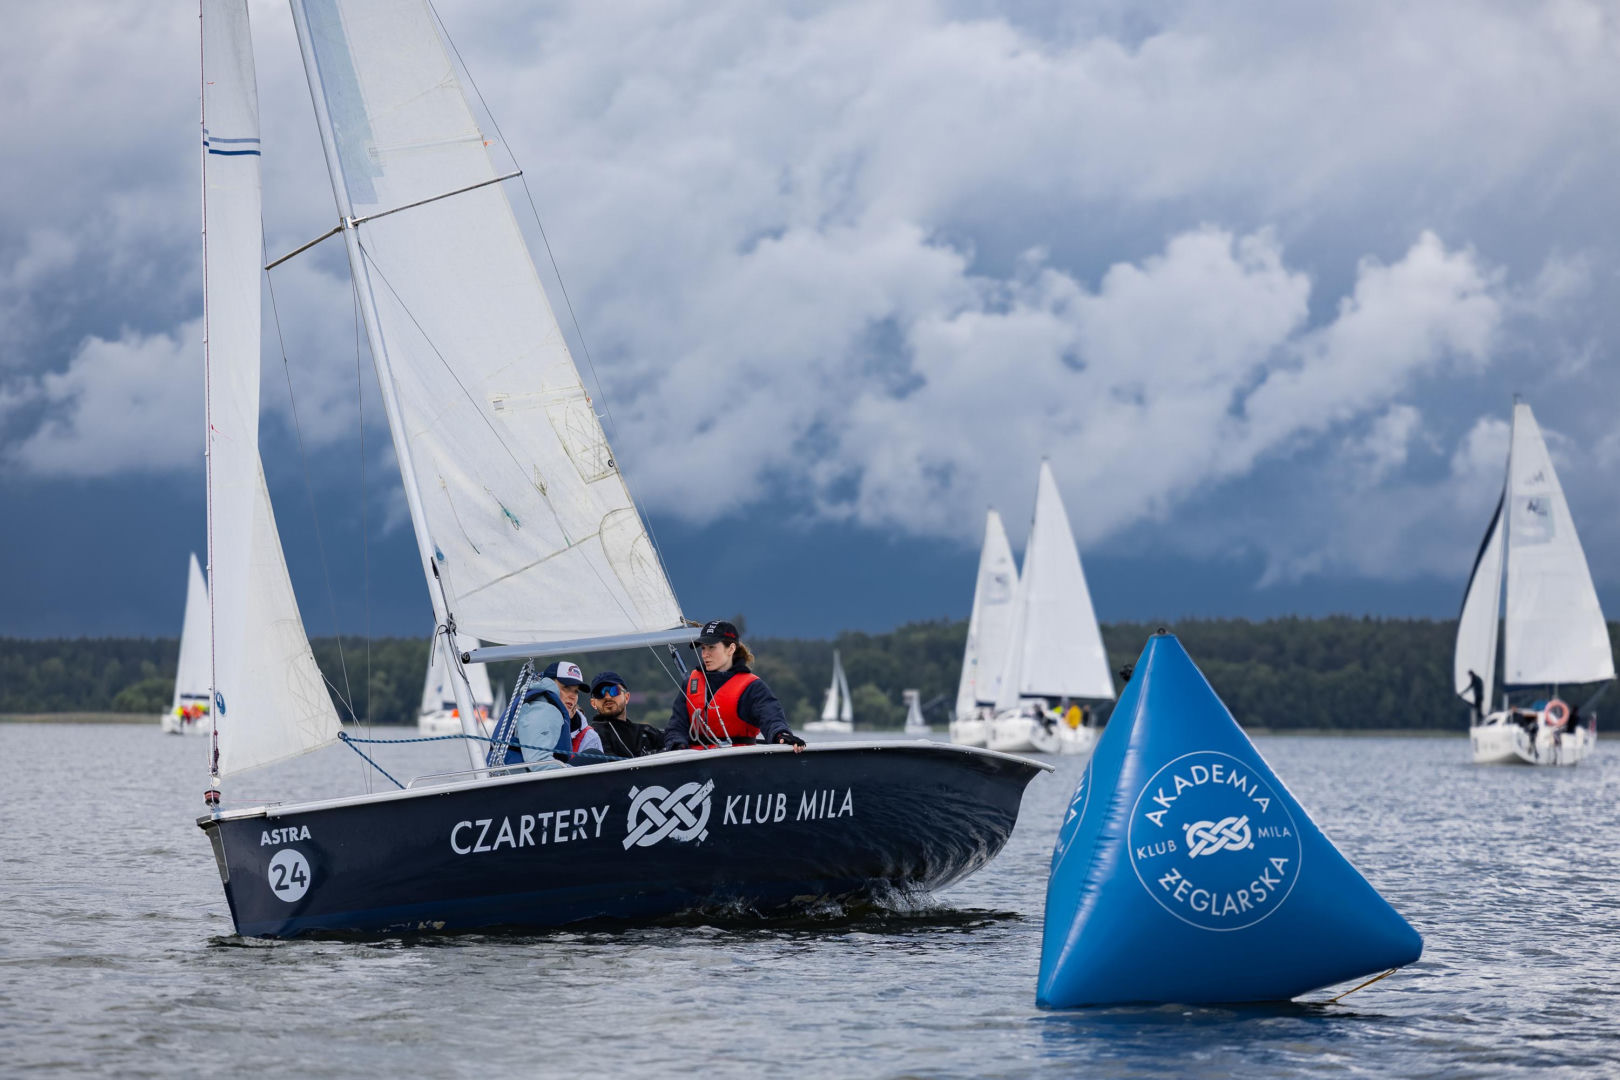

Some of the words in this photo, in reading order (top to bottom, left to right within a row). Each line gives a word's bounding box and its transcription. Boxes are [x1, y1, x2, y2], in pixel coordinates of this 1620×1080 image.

[1145, 764, 1270, 828] AKADEMIA
[260, 825, 312, 847] ASTRA
[450, 805, 610, 855] CZARTERY
[723, 793, 787, 825] KLUB
[796, 787, 853, 821] MILA
[1136, 840, 1177, 860] KLUB
[1258, 826, 1292, 838] MILA
[272, 862, 307, 891] 24
